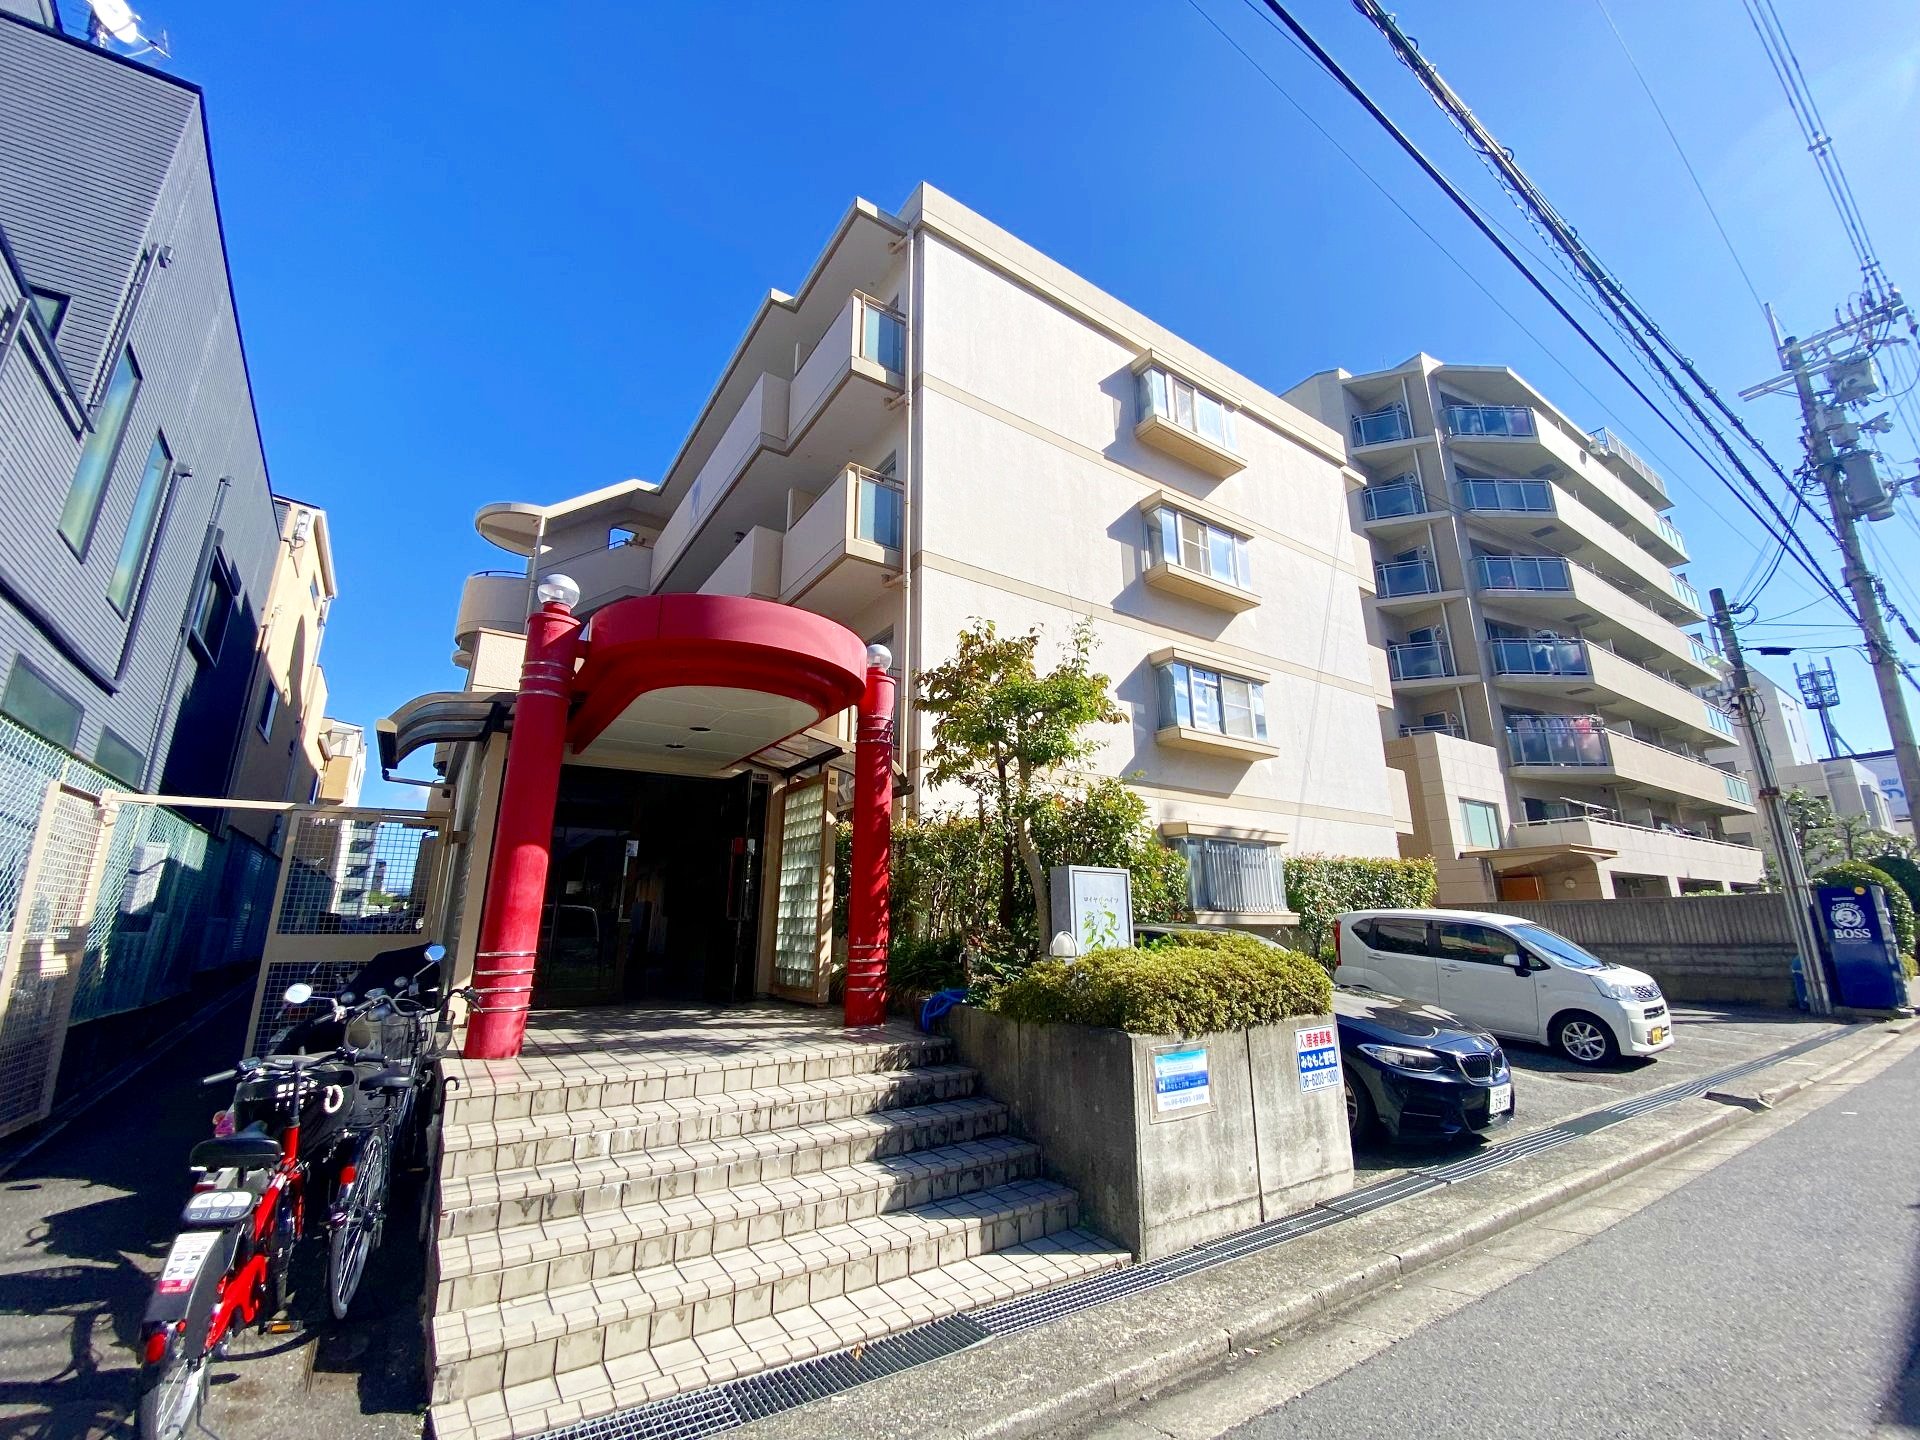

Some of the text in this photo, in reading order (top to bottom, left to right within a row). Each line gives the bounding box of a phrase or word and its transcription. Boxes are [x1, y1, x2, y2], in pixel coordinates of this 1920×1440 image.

[1833, 928, 1871, 939] BOSS
[1299, 1030, 1333, 1049] 入居者募集
[1300, 1050, 1336, 1068] みなもと管理
[1302, 1069, 1338, 1088] 06-6203-1300
